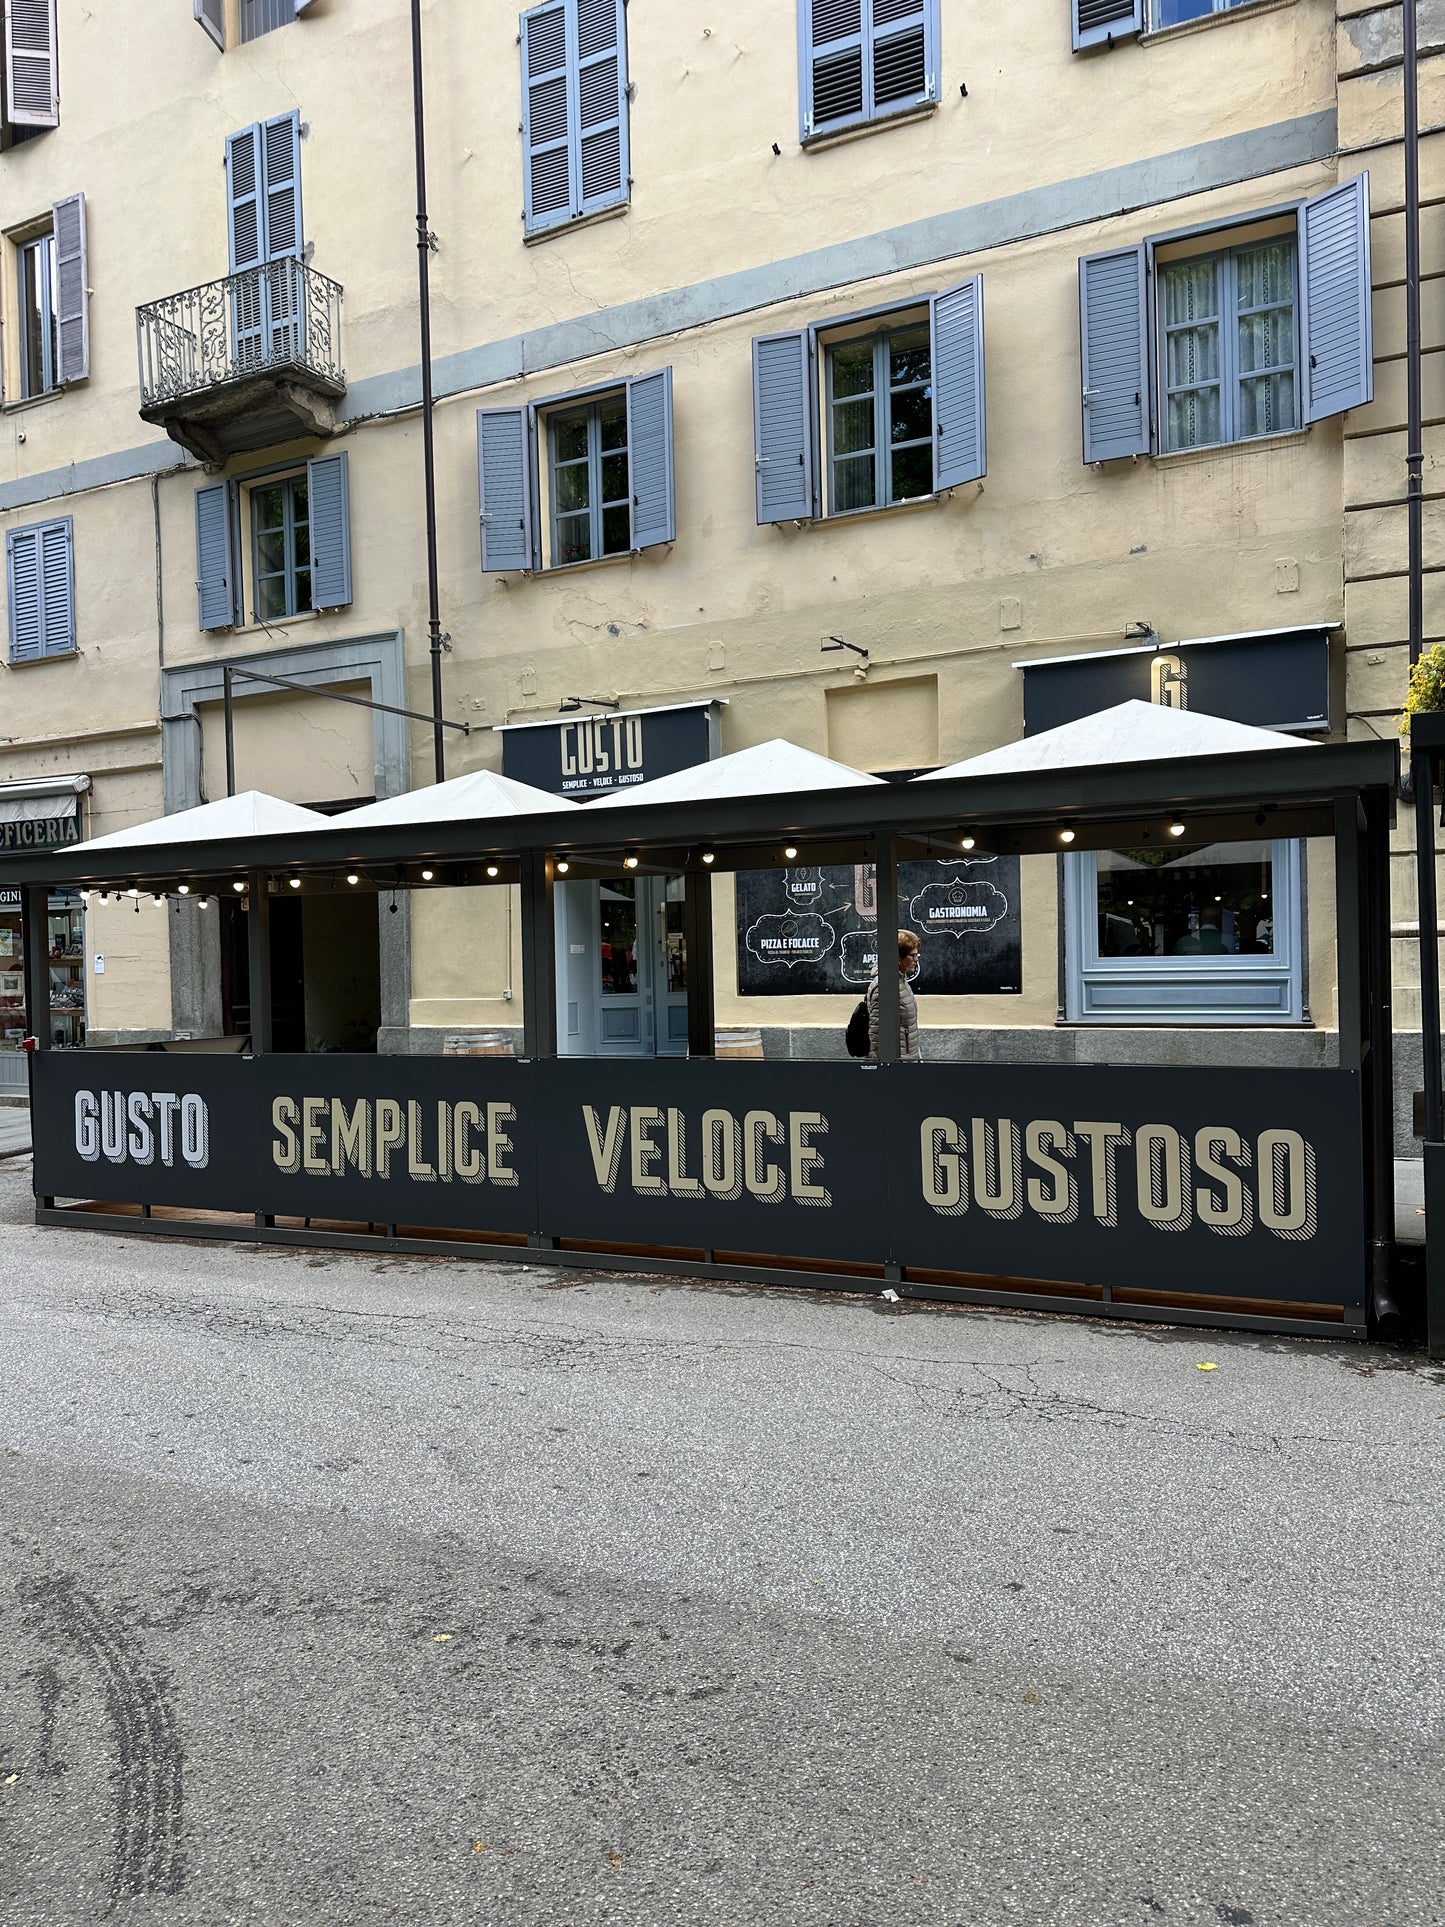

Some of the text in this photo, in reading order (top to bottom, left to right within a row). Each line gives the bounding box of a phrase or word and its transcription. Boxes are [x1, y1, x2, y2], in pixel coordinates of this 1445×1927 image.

[1151, 655, 1188, 710] G
[560, 715, 643, 776] GUSTO
[562, 779, 587, 790] SEMPLICE
[593, 776, 613, 787] VELOCE
[618, 773, 644, 784] GUSTOSO
[791, 883, 816, 892] GELATO
[929, 906, 988, 919] GASTRONOMIA
[761, 938, 820, 949] PIZZA E FOCACCE
[863, 954, 878, 964] APE
[75, 1090, 209, 1168] GUSTO
[273, 1097, 1317, 1240] SEMPLICE VELOCE GUSTOSO
